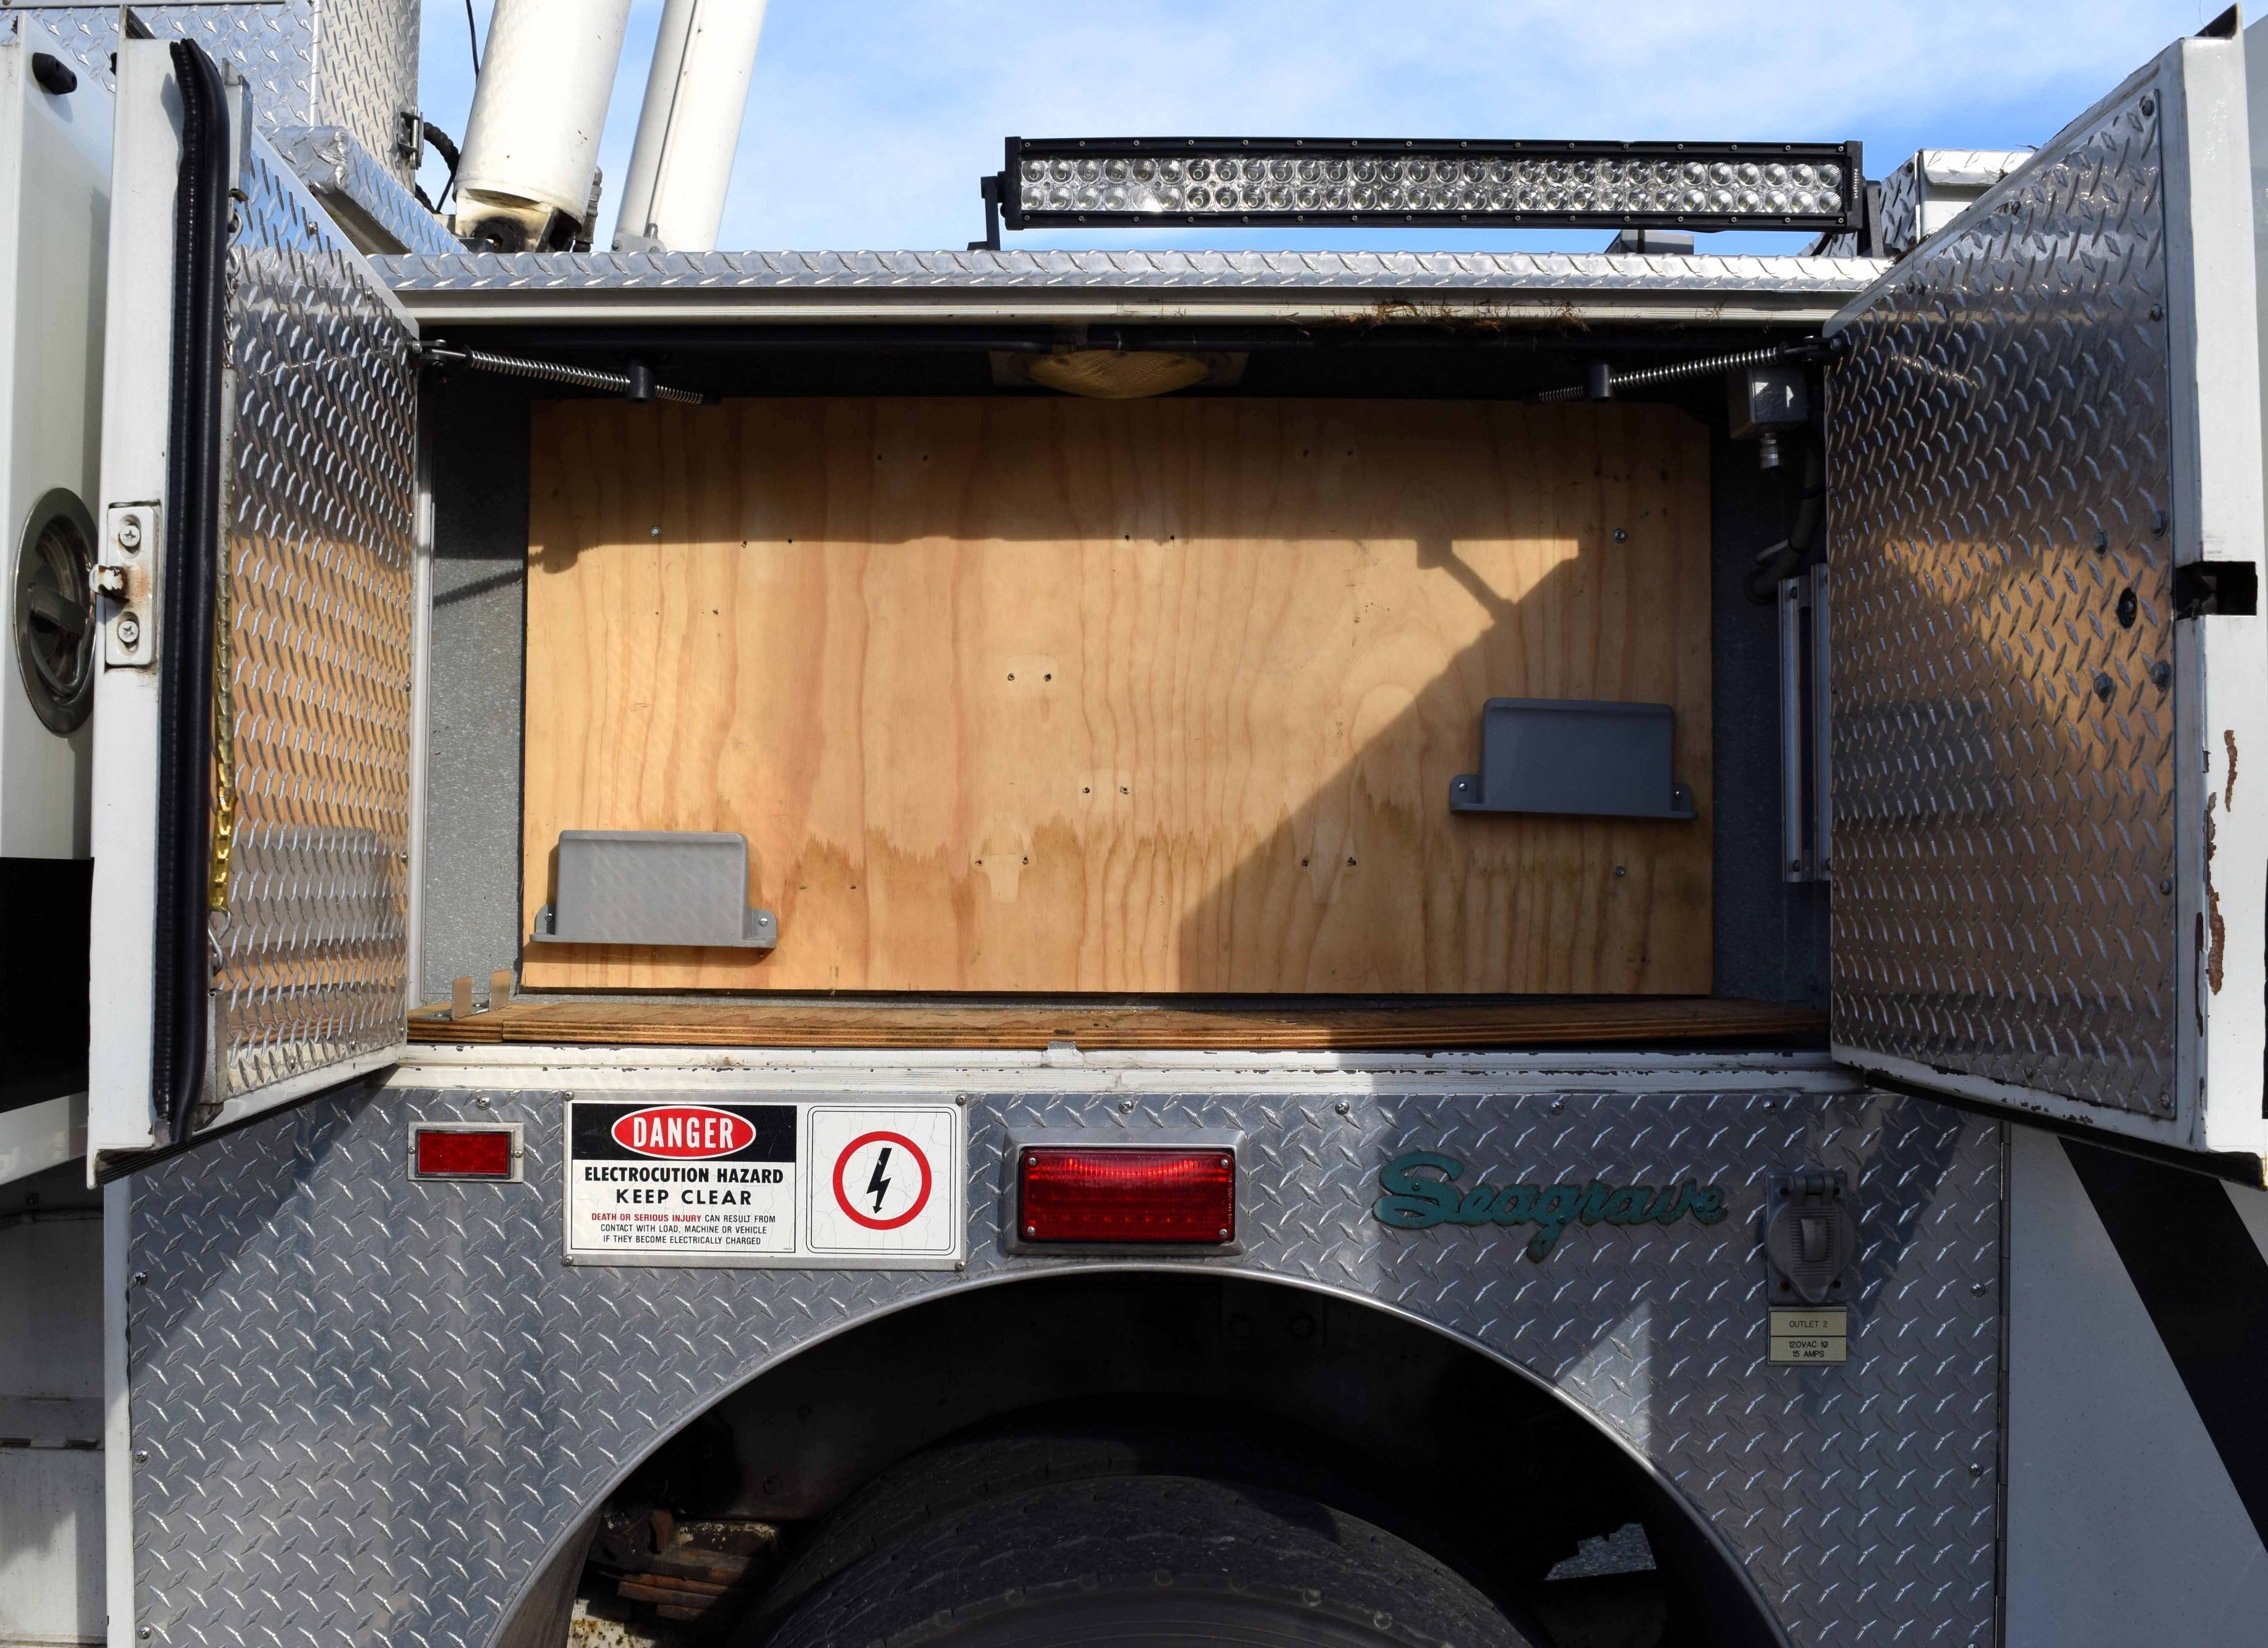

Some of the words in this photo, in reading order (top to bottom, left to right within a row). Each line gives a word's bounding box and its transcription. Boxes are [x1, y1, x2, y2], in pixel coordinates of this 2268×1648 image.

[633, 1116, 734, 1149] DANGER
[585, 1167, 709, 1183] ELECTROCUTION
[717, 1168, 783, 1184] HAZARD
[616, 1189, 669, 1204] KEEP
[681, 1190, 751, 1205] CLEAR
[1373, 1151, 1728, 1262] Seagrave
[659, 1225, 681, 1233] LOAD,
[685, 1225, 719, 1233] MACHINE
[670, 1236, 722, 1244] ELECTRICALLY
